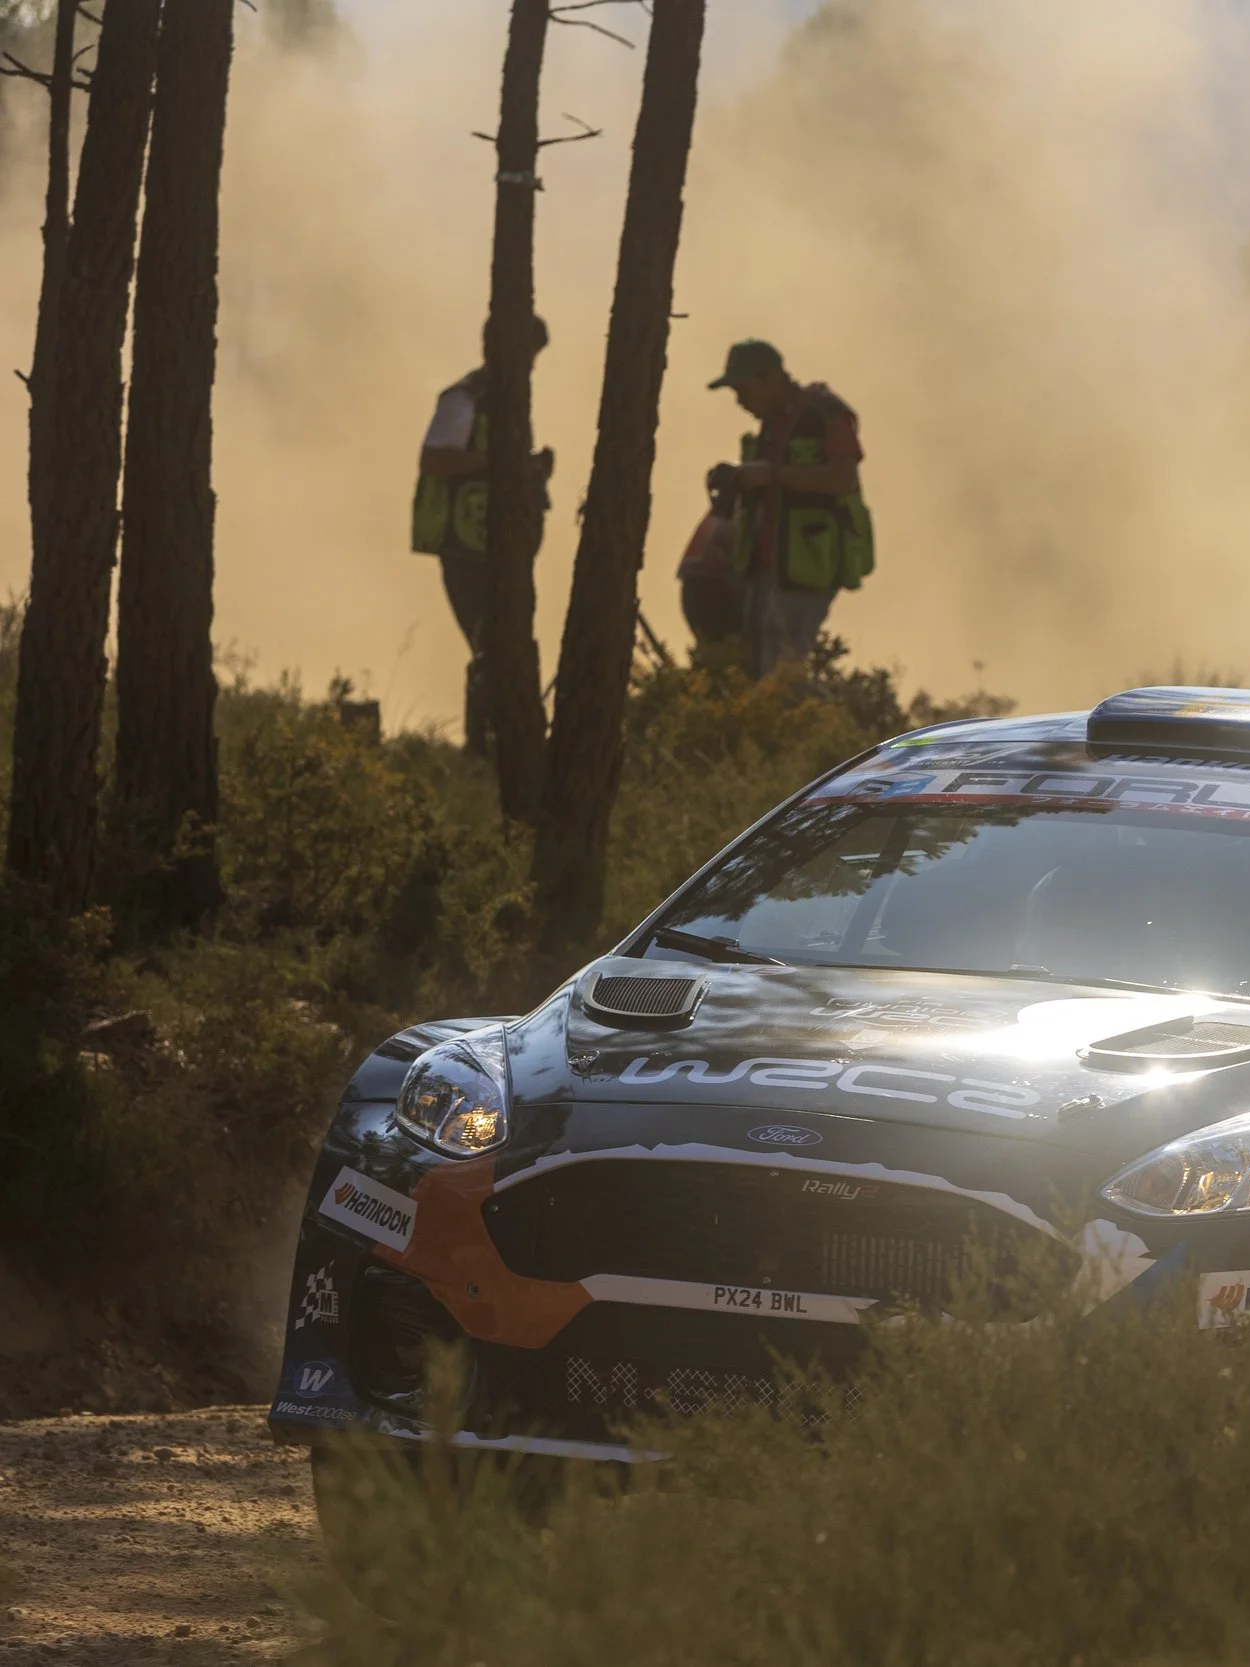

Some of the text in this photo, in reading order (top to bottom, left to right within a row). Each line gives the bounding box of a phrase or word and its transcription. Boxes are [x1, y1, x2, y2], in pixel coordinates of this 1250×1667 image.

[619, 1057, 1041, 1119] WRC2
[758, 1126, 811, 1145] Ford
[713, 1286, 808, 1314] PX24 BWL
[299, 1367, 334, 1393] W
